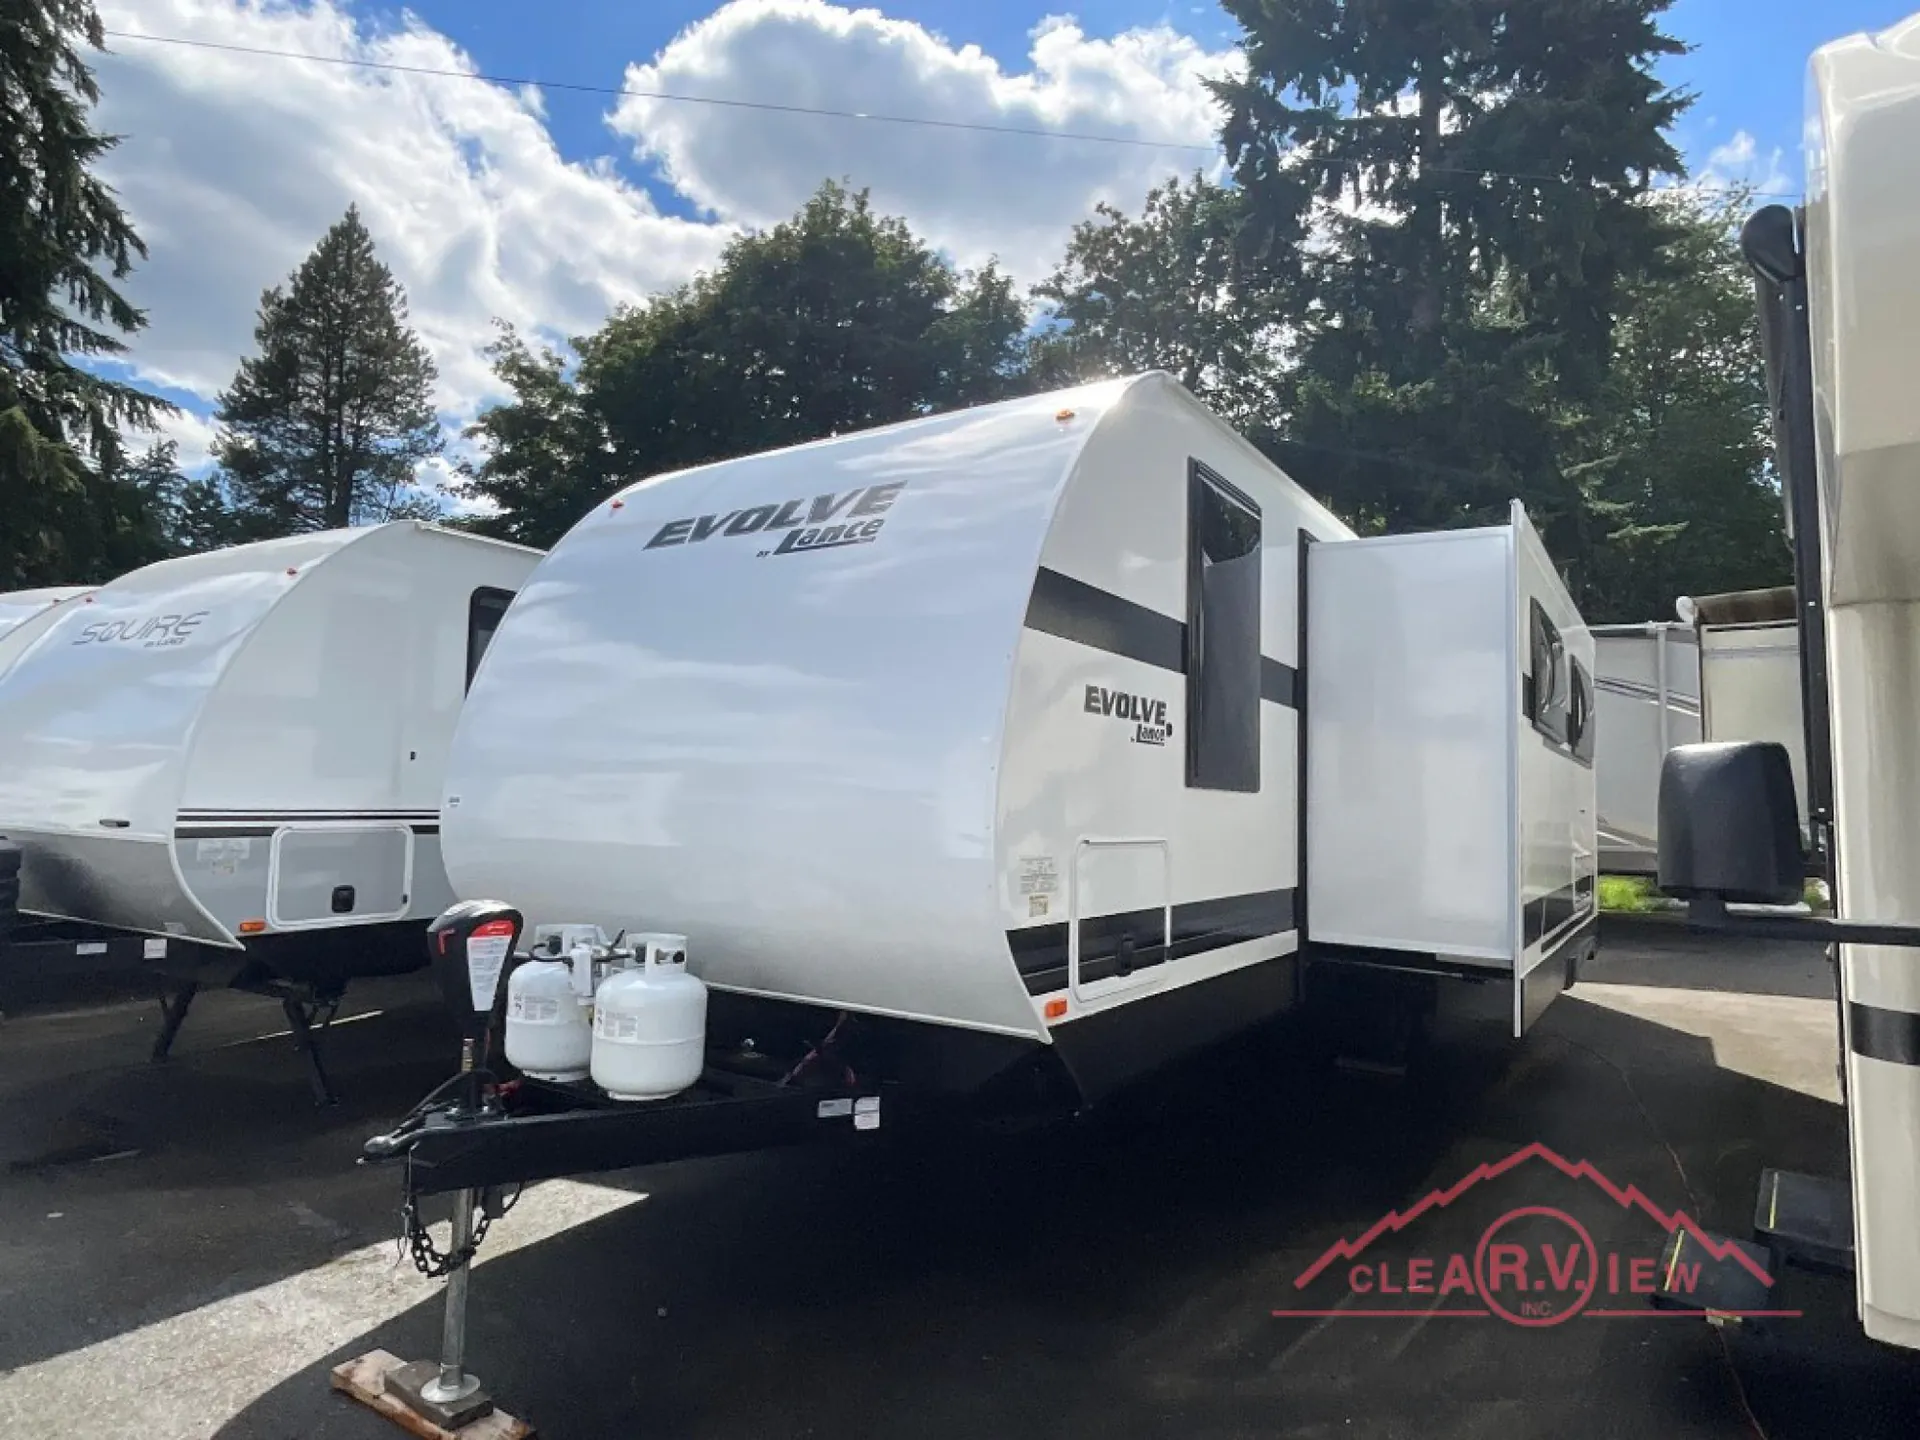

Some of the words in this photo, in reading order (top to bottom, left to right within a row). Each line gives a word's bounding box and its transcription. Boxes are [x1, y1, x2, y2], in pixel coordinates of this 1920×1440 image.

[642, 480, 908, 551] EVOLVE
[773, 518, 885, 555] Lance
[72, 610, 210, 645] SQUIRE
[1084, 684, 1167, 726] EVOLVE
[1136, 723, 1165, 746] Lance
